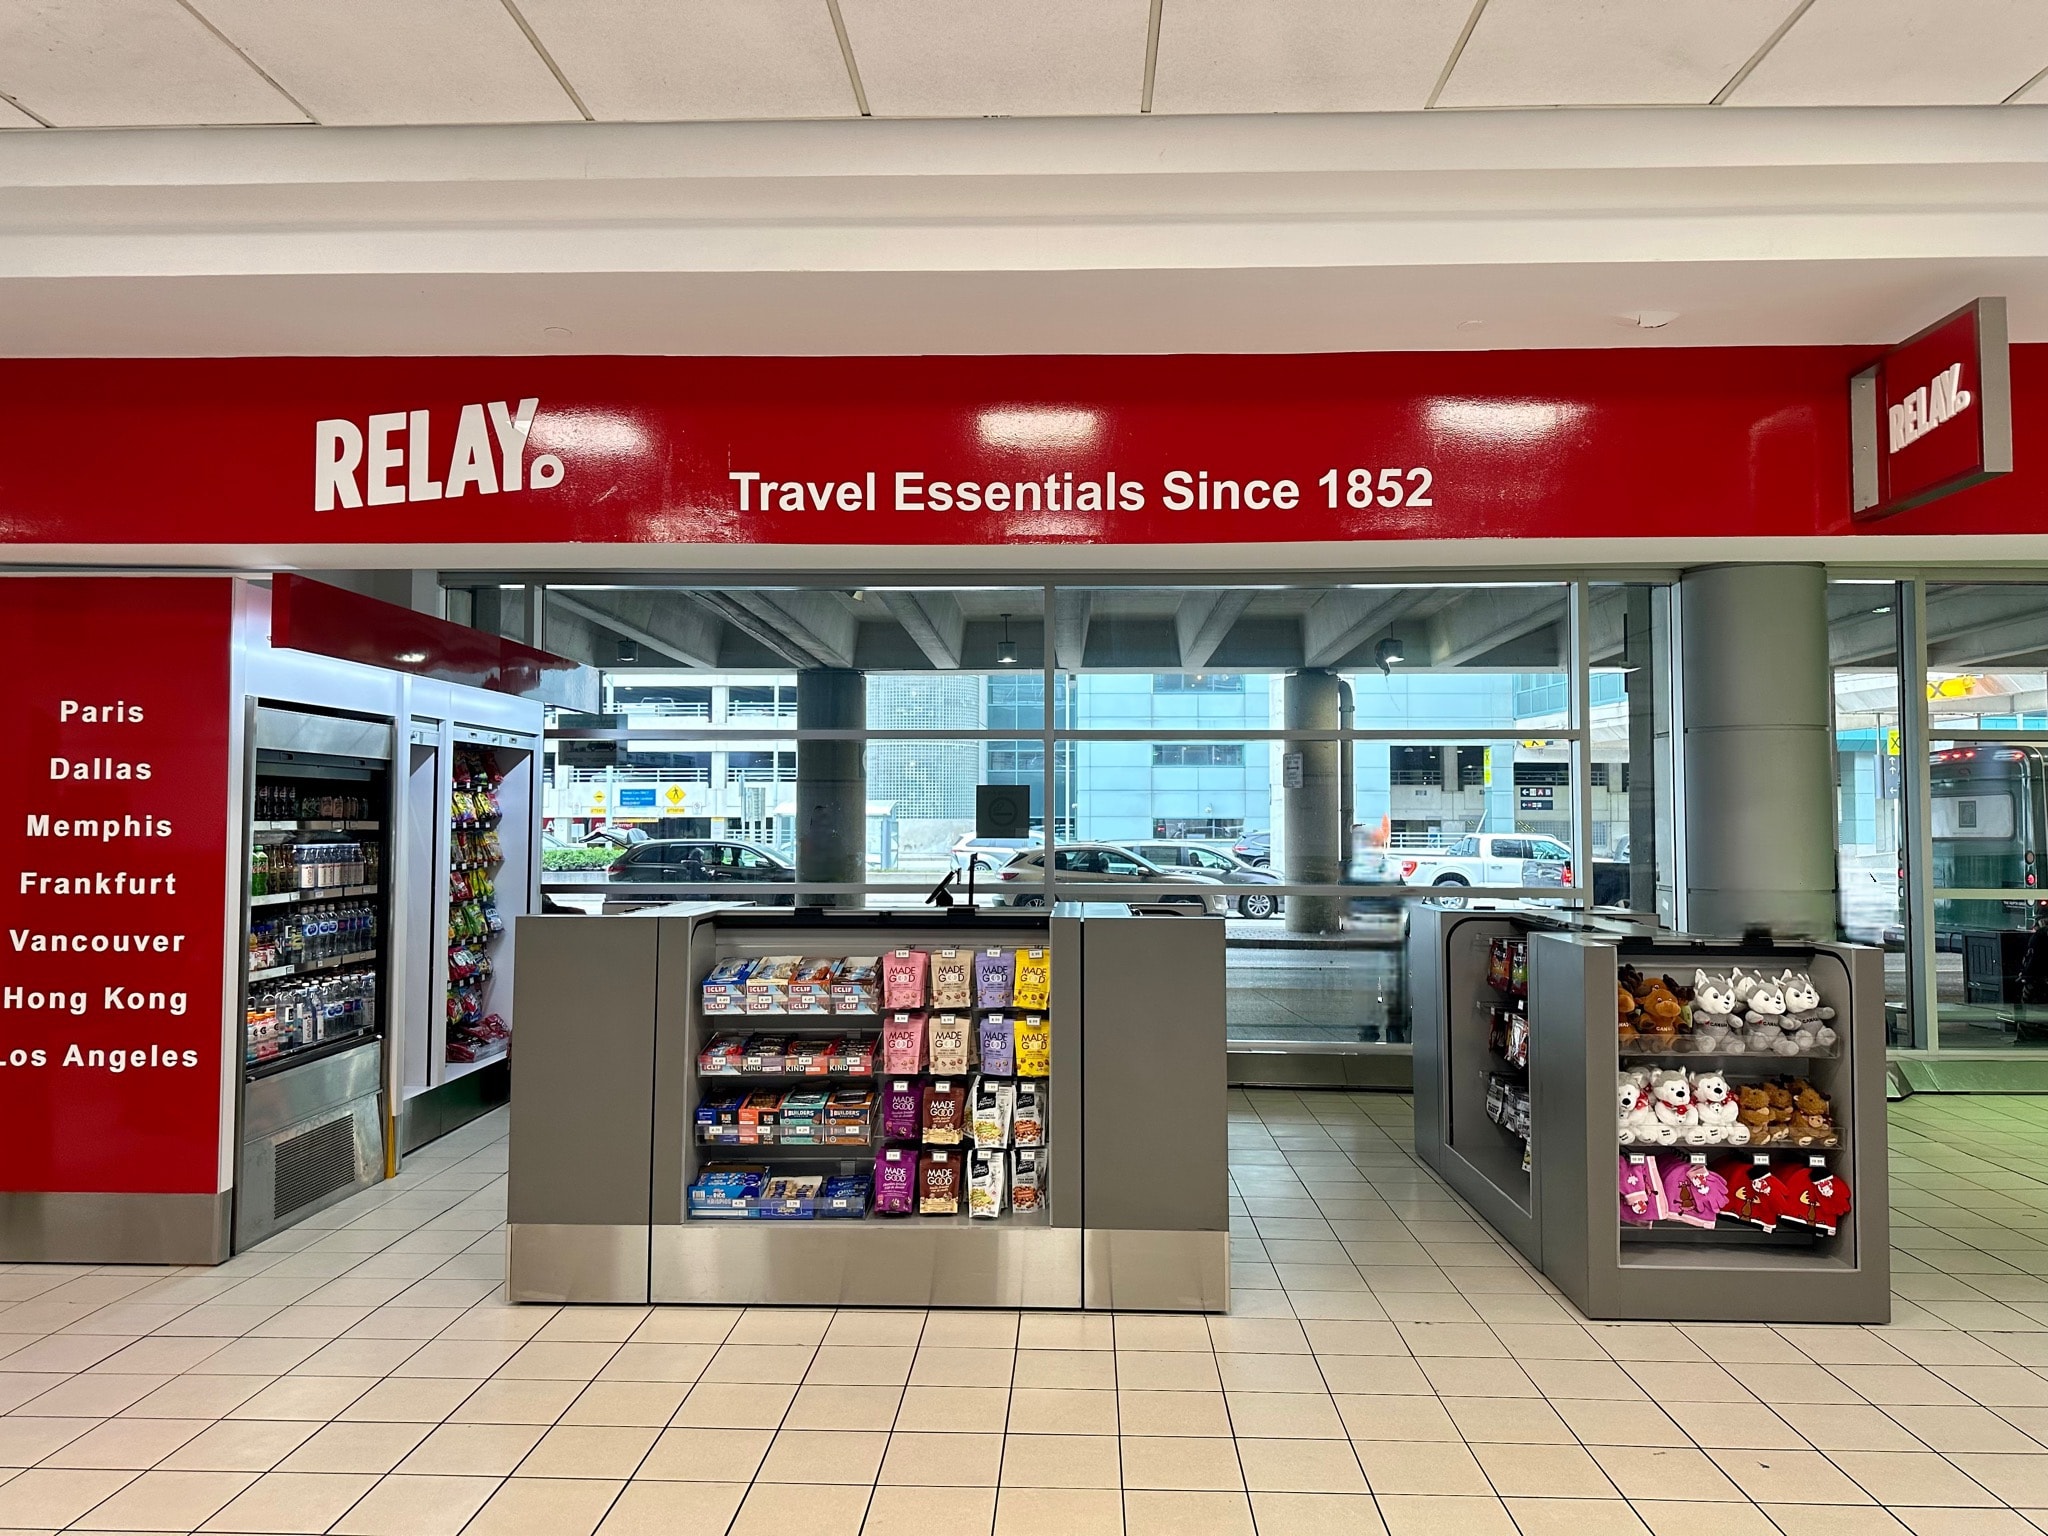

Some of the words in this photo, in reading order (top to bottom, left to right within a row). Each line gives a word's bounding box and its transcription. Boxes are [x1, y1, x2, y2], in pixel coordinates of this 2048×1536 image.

[729, 470, 876, 512] Travel
[894, 470, 1145, 513] Essentials
[1162, 469, 1300, 511] Since
[1318, 467, 1434, 510] 1852
[59, 699, 145, 723] Paris
[49, 757, 153, 780] Dallas
[26, 814, 173, 842] Memphis
[20, 872, 177, 895] Frankfurt
[9, 929, 185, 952] Vancouver
[889, 966, 916, 974] MADE
[938, 965, 964, 974] MADE
[982, 966, 1008, 975] MADE
[1022, 966, 1047, 976] MADE
[2, 986, 89, 1016] Hong
[103, 986, 188, 1016] Kong
[888, 1031, 914, 1040] MADE
[935, 1031, 962, 1040] MADE
[984, 1032, 1008, 1041] MADE
[1022, 1033, 1048, 1042] MADE
[62, 1044, 199, 1073] Angeles
[930, 1100, 955, 1108] MADE
[884, 1167, 907, 1175] MADE
[927, 1169, 952, 1177] MADE
